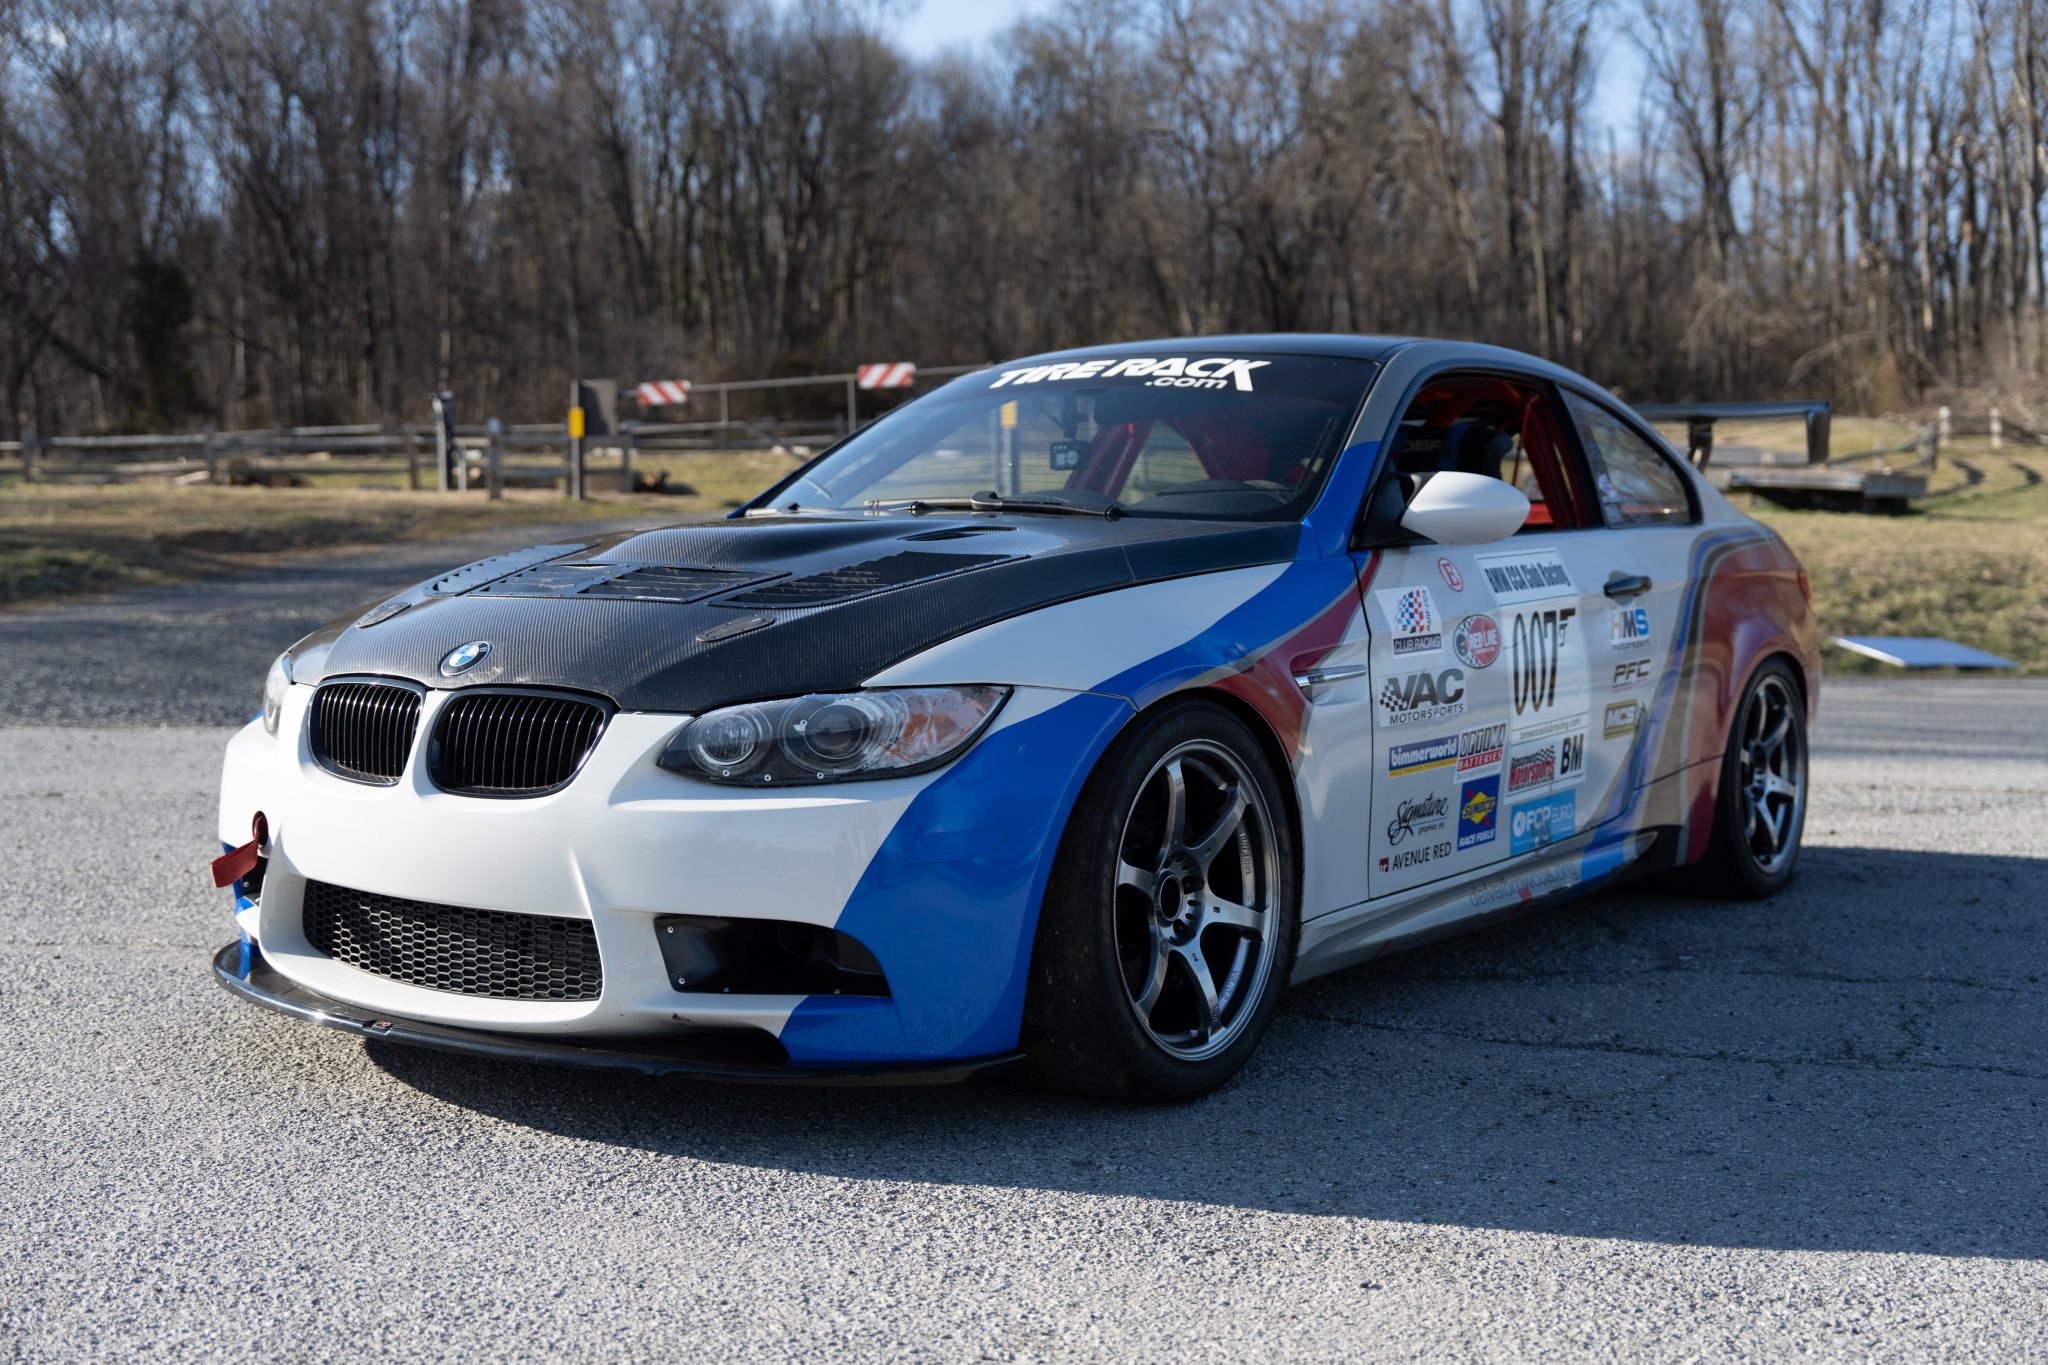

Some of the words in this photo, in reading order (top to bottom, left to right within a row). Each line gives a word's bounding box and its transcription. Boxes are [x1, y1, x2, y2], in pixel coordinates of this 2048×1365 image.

[1144, 376, 1228, 389] .com
[1484, 567, 1513, 593] BMW
[1520, 563, 1546, 589] Club
[1536, 561, 1571, 587] Racing
[1610, 608, 1649, 640] HMS
[1393, 639, 1414, 653] CLUB
[1414, 636, 1440, 651] RACING
[1469, 631, 1484, 649] RED
[1483, 629, 1498, 647] LINE
[1612, 658, 1651, 683] PFC
[1387, 668, 1464, 712] VAC
[1389, 703, 1464, 725] MOTORSPORTS
[1391, 737, 1457, 768] bimmerworld
[1460, 723, 1507, 757] OPTIMA
[1560, 733, 1584, 775] BM
[1457, 750, 1502, 771] BATTERIES
[1387, 790, 1449, 847] Signature
[1462, 797, 1496, 819] SUNOCO
[1526, 806, 1551, 832] FCP
[1551, 803, 1573, 823] EURO
[1458, 833, 1477, 848] RACE
[1476, 828, 1495, 843] FUELS
[1392, 846, 1431, 871] AVENUE
[1433, 842, 1452, 860] RED
